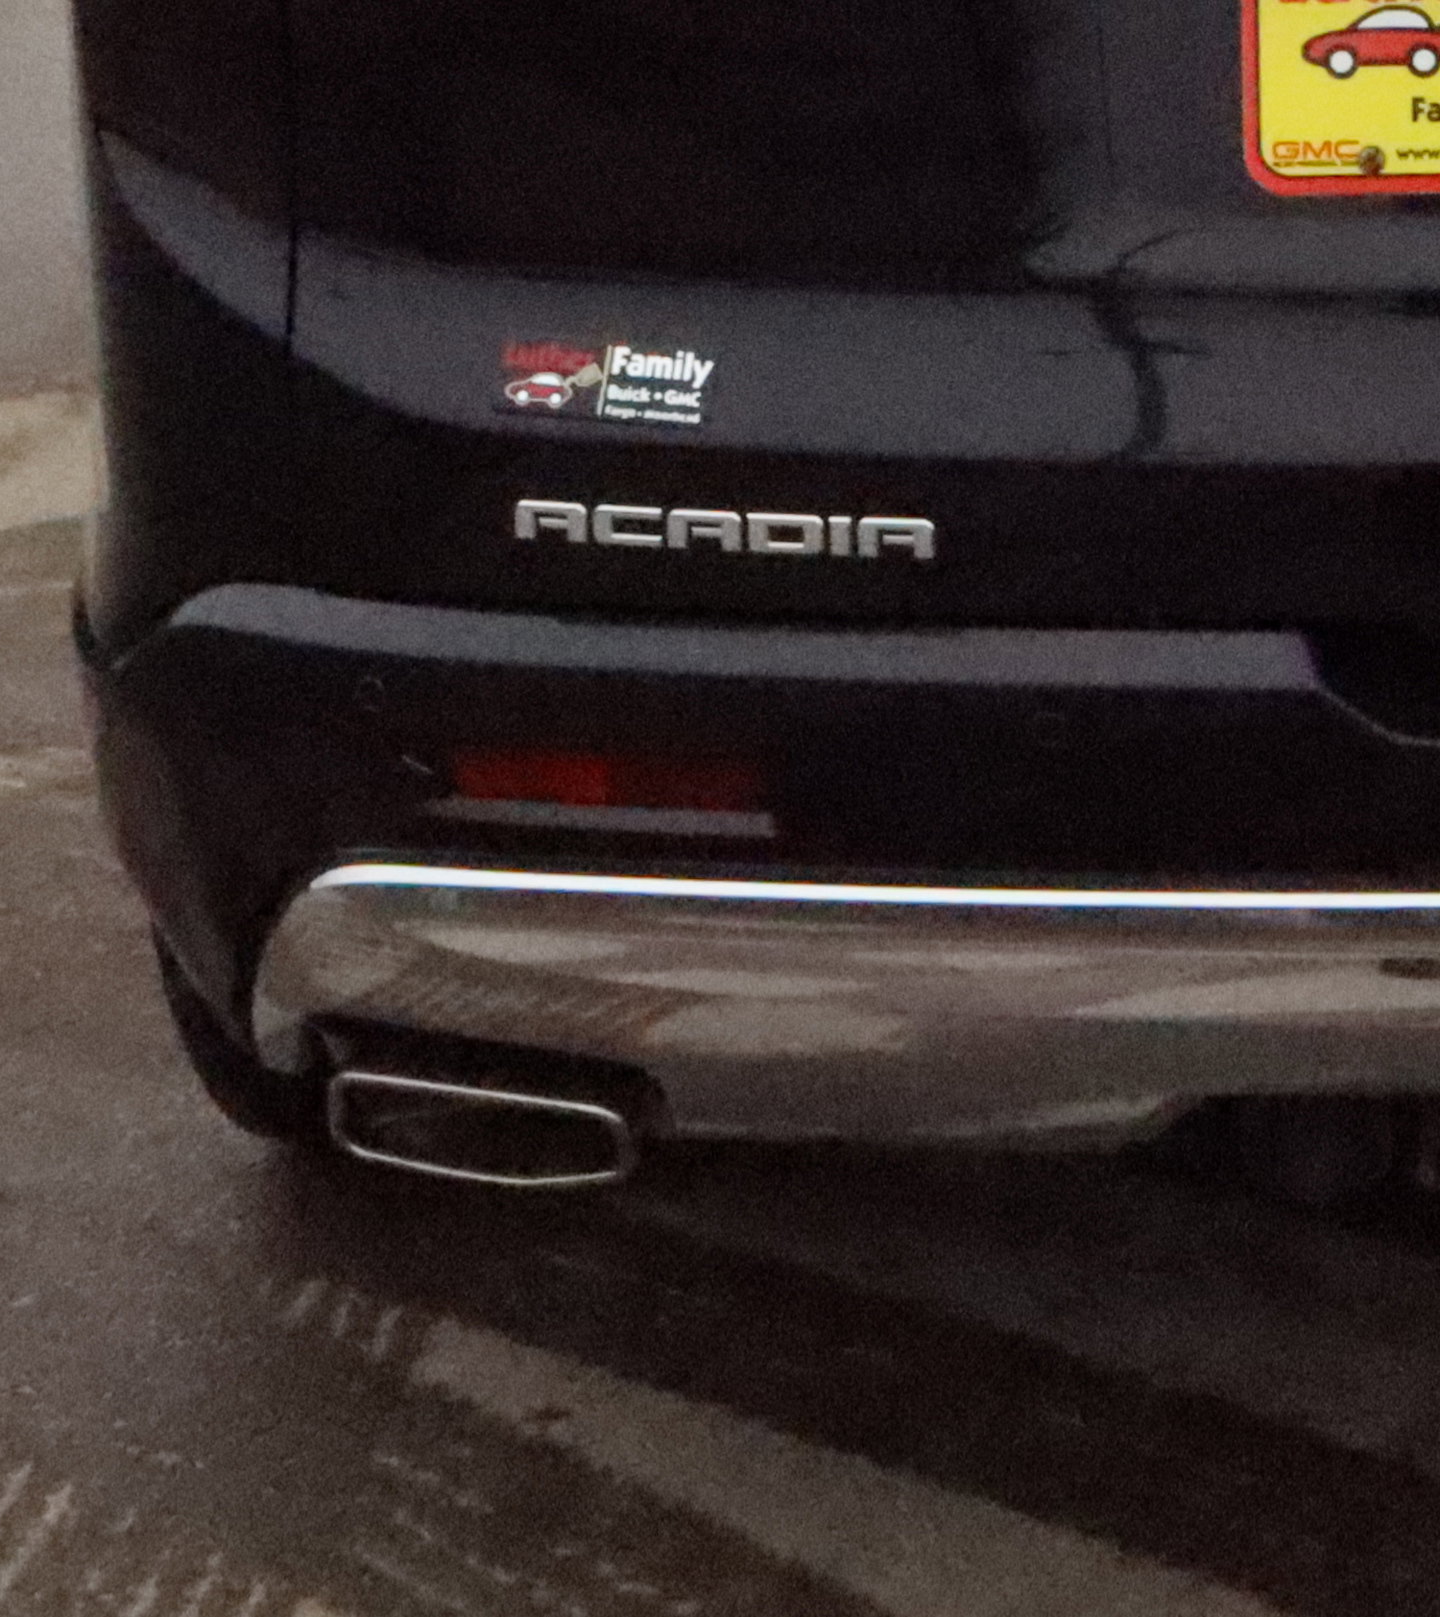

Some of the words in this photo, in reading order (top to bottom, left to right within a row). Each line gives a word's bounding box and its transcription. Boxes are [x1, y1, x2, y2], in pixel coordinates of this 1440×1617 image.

[1271, 139, 1361, 162] GMC
[610, 344, 715, 390] Family
[607, 384, 651, 403] Buick
[663, 388, 702, 408] GMC
[513, 498, 936, 560] ACADIA
